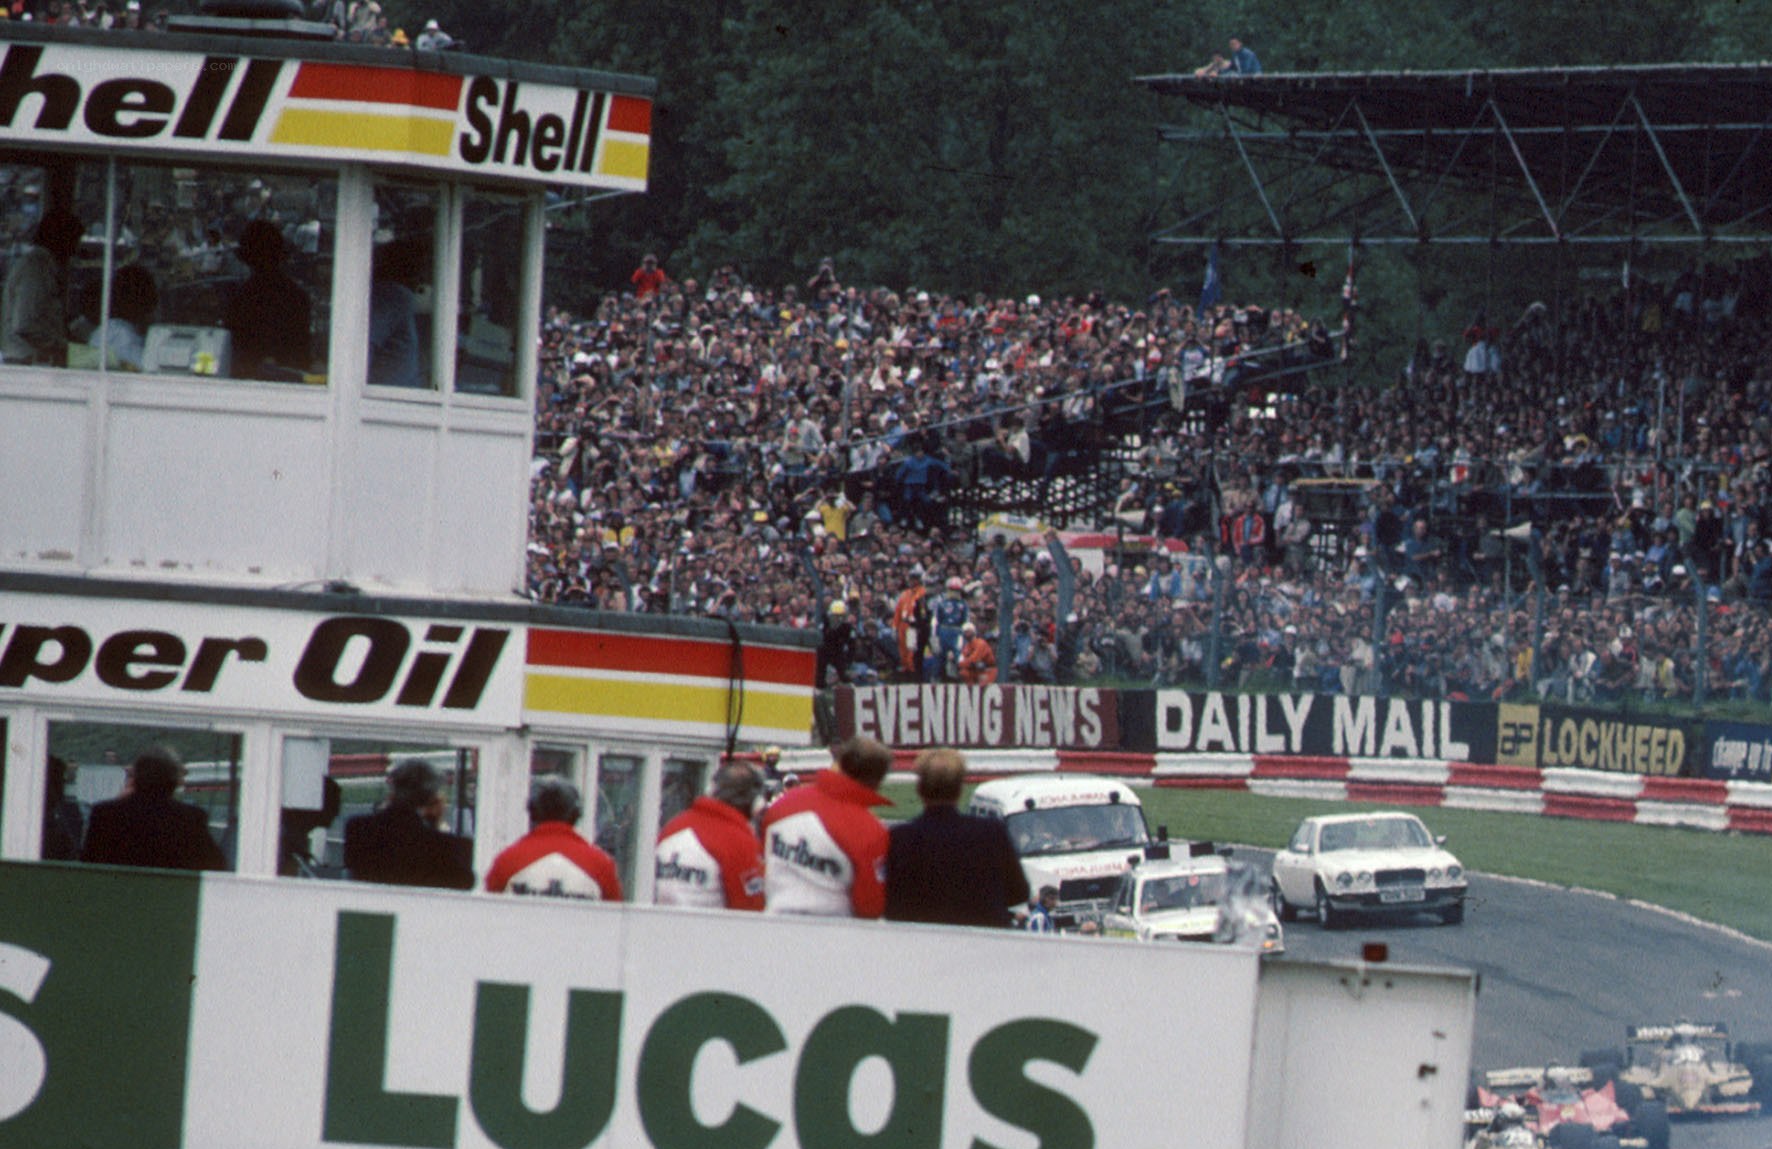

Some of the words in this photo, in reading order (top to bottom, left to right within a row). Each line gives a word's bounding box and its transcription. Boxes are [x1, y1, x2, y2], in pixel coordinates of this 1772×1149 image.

[460, 75, 606, 175] Shell
[0, 623, 268, 693] per
[293, 615, 512, 710] Oil
[854, 683, 1003, 749] EVENING
[1012, 687, 1104, 750] NEWS
[1155, 690, 1317, 757] DAILY
[1331, 695, 1470, 762] MAIL
[1541, 716, 1687, 776] LOCKHEED
